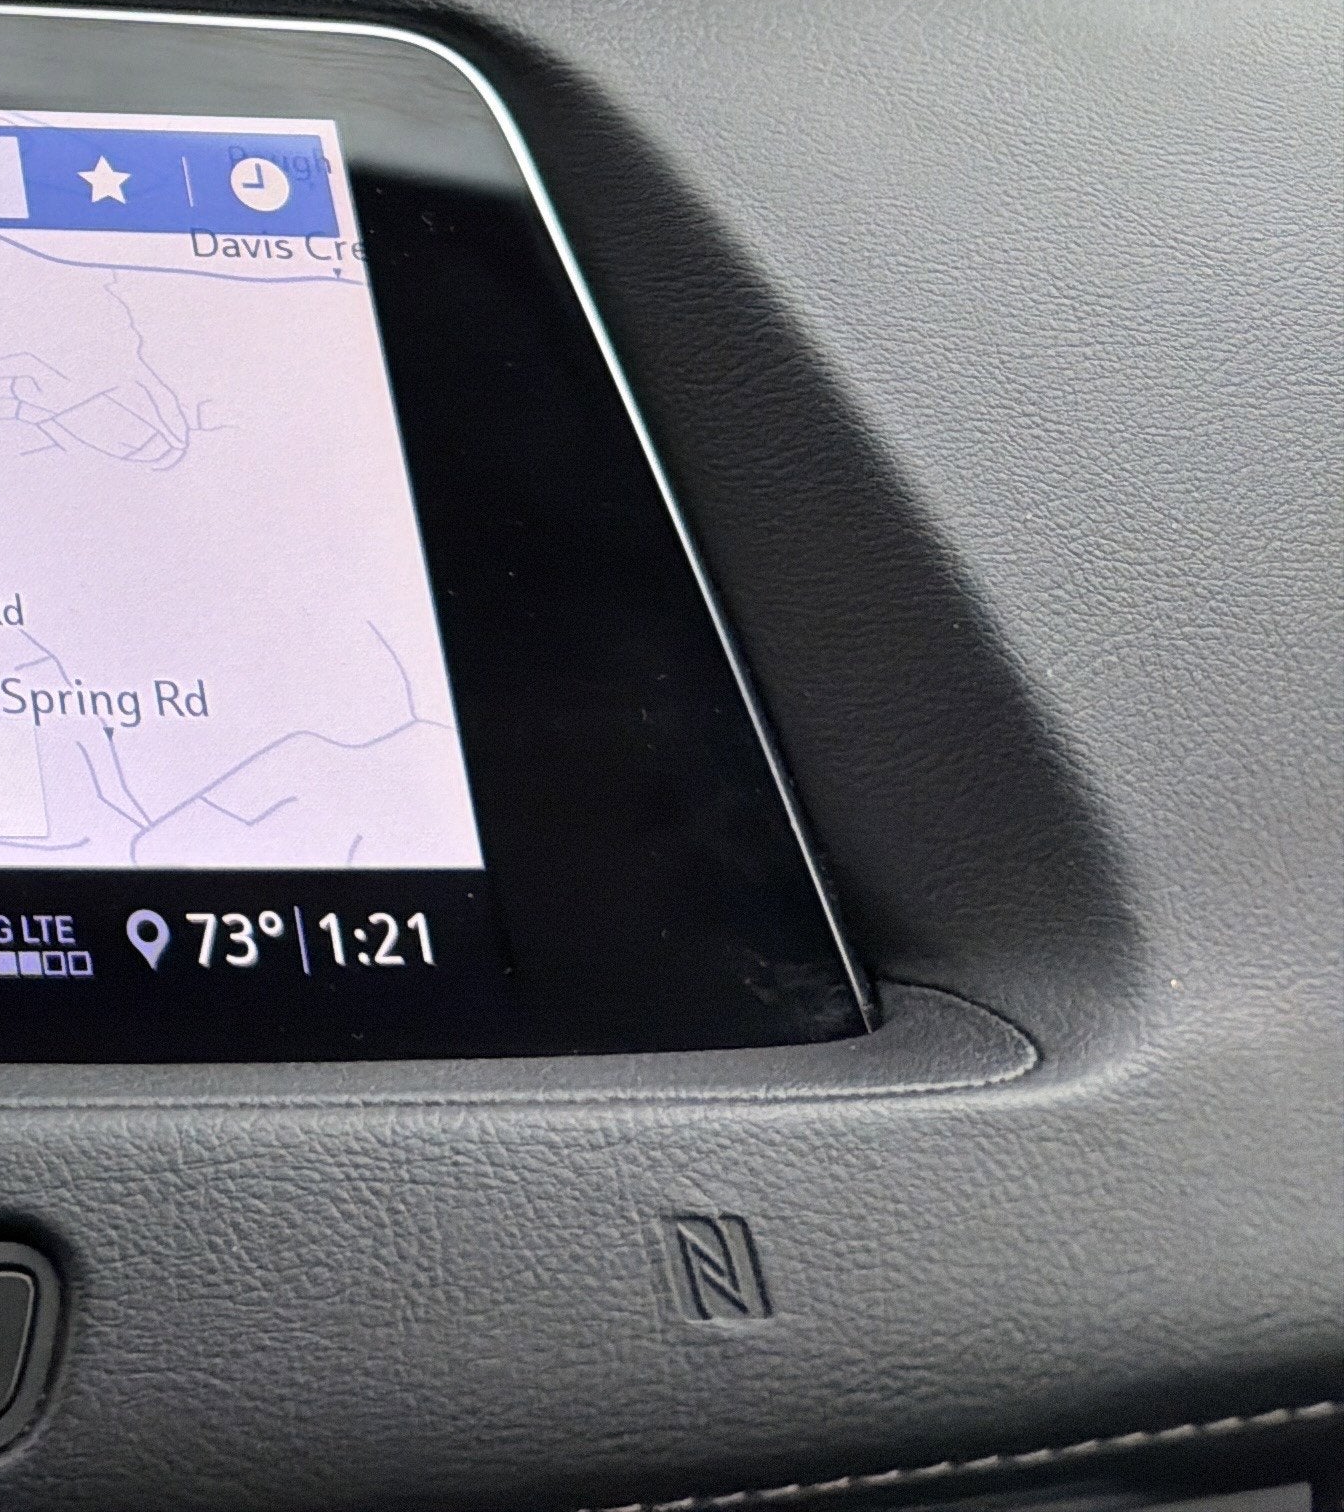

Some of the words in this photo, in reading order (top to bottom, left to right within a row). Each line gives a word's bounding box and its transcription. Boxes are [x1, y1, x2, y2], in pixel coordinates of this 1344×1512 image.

[191, 228, 293, 260] Davis
[2, 678, 141, 727] Spring
[154, 680, 209, 717] Rd
[23, 916, 74, 944] LTE
[187, 911, 284, 967] 73°
[320, 912, 436, 966] 1:21
